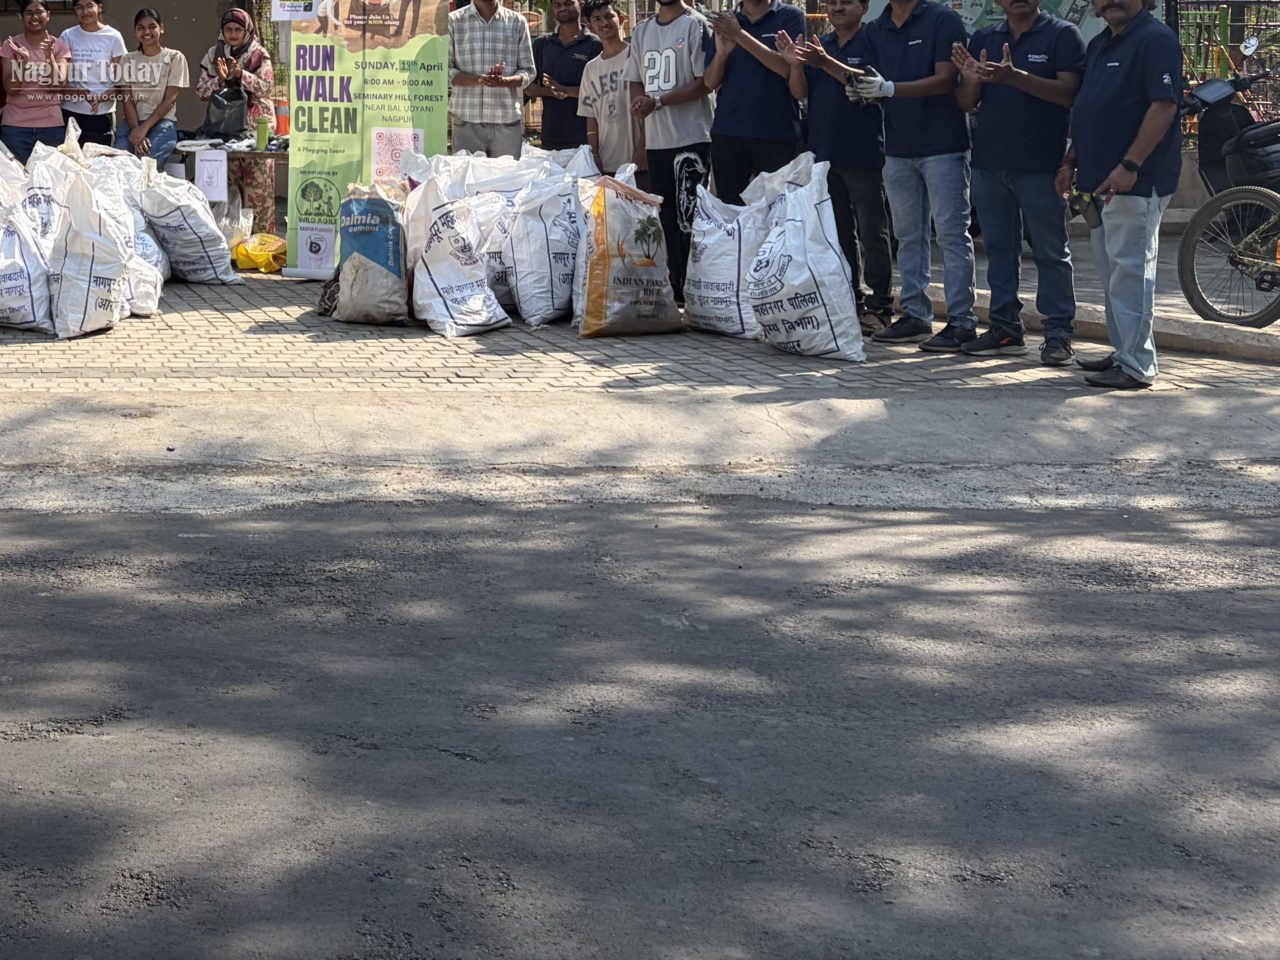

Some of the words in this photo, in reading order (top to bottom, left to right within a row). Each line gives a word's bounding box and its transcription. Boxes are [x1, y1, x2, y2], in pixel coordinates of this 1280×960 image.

[295, 44, 335, 71] RUN
[354, 61, 398, 72] SUNDAY,
[419, 62, 444, 73] April
[644, 48, 677, 93] 20
[295, 75, 352, 102] WALK
[353, 93, 393, 101] SEMINARY
[403, 105, 434, 113] UDYAN)
[294, 106, 358, 134] CLEAN
[381, 115, 414, 123] NAGPUR
[298, 216, 316, 224] WILD
[317, 217, 337, 225] AGILE
[341, 213, 380, 227] Dalmia
[348, 225, 380, 233] cement
[613, 276, 644, 286] INDIAN
[786, 292, 819, 313] पालिका
[783, 319, 819, 338] विभाग)
